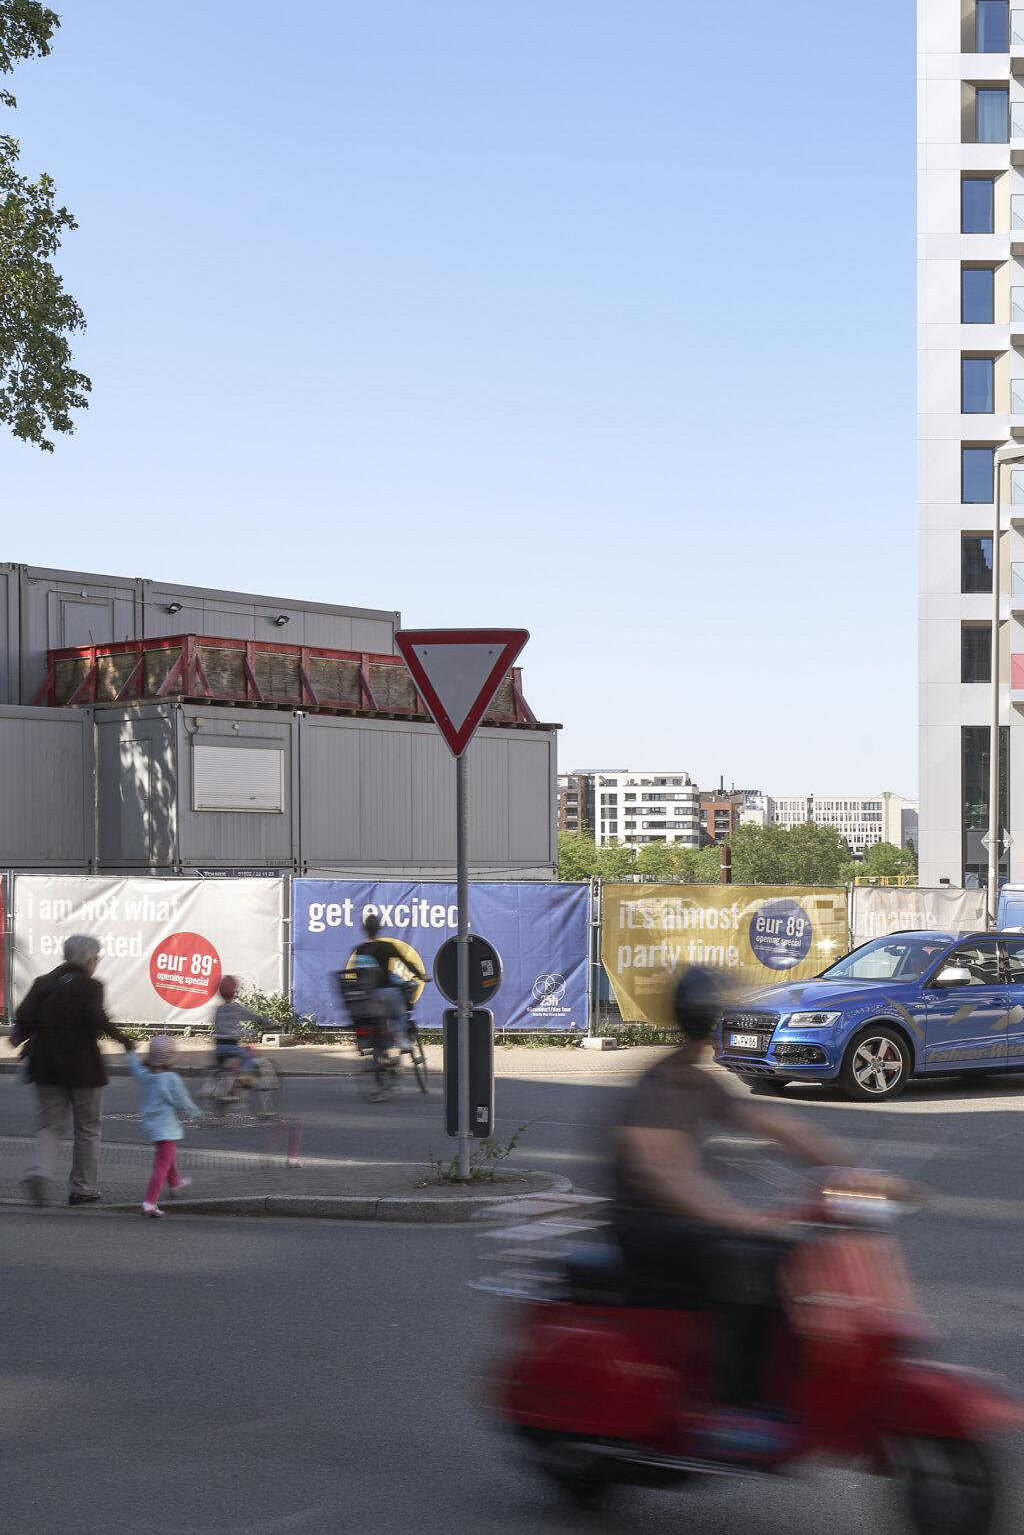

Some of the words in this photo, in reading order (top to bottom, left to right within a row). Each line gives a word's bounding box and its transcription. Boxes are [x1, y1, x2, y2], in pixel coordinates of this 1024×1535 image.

[27, 893, 33, 919] i
[40, 898, 72, 921] am
[81, 895, 120, 921] not
[124, 894, 180, 922] what
[308, 898, 354, 933] get
[619, 899, 654, 929] it's
[662, 899, 739, 929] almost
[756, 917, 783, 934] eur
[28, 929, 33, 954] i
[40, 931, 149, 958] exted.
[756, 935, 780, 945] opening
[781, 938, 801, 947] special
[157, 953, 187, 972] eur
[617, 940, 680, 974] party
[688, 939, 745, 967] time.
[157, 972, 184, 984] opening
[185, 976, 209, 986] special
[540, 994, 559, 1006] 25h
